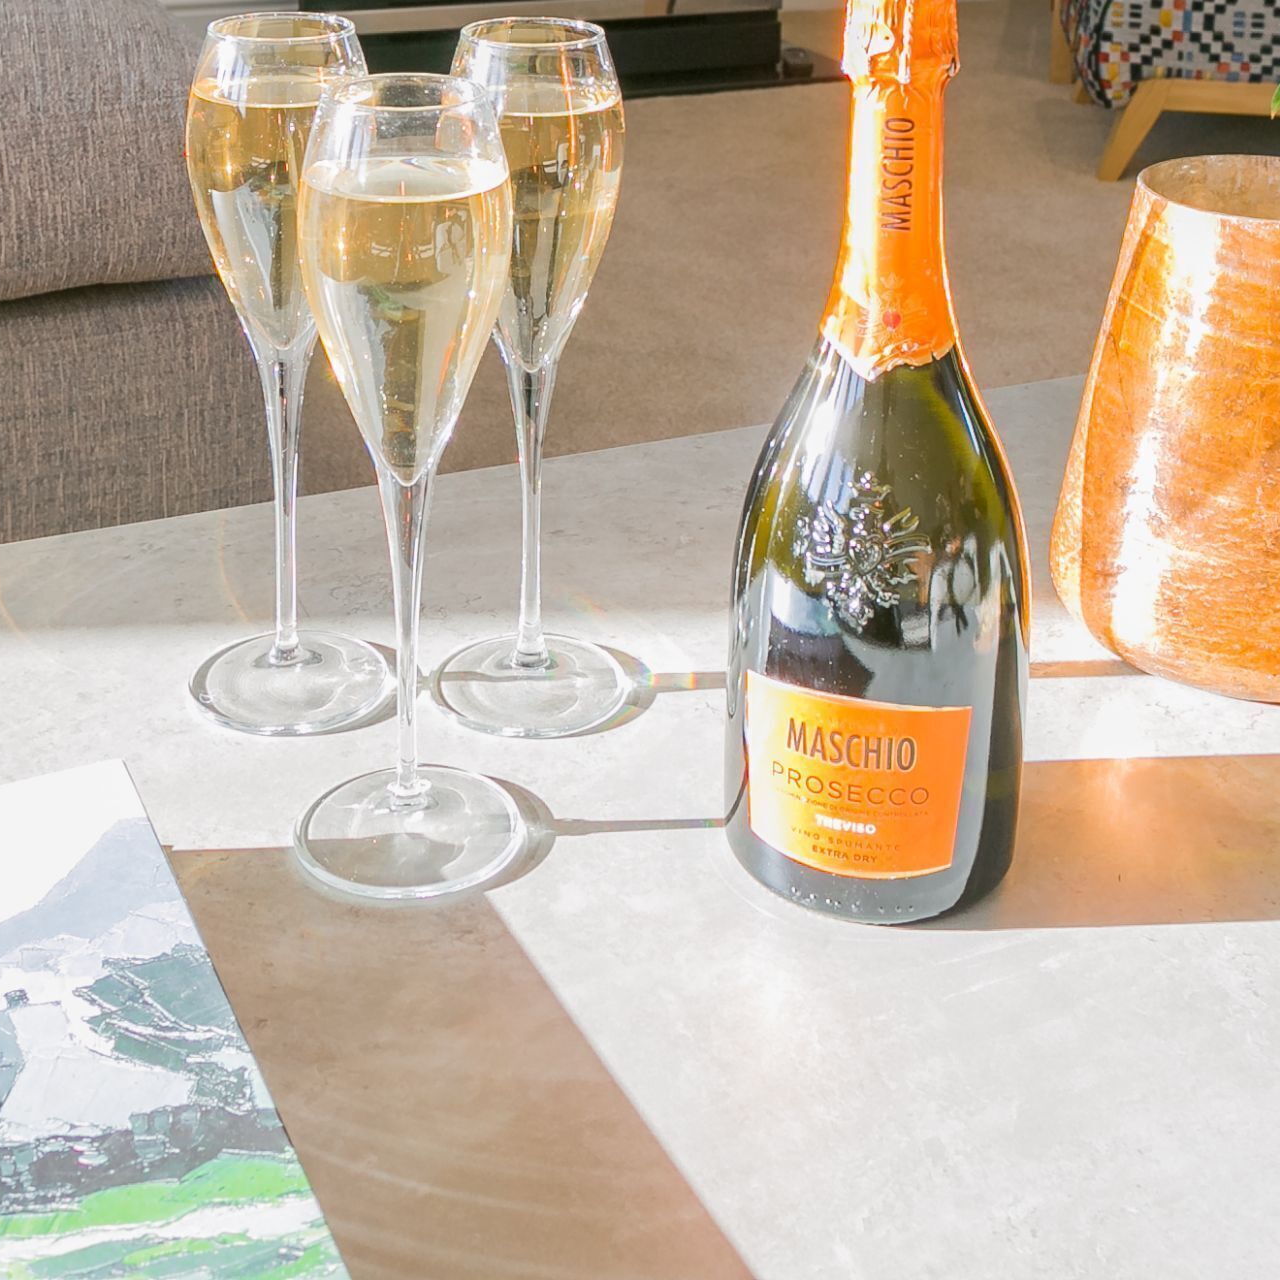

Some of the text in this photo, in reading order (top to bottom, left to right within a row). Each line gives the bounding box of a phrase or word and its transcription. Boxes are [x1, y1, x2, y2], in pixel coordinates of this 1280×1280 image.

[879, 118, 915, 232] MASCHIO
[786, 717, 917, 772] MASCHIO
[770, 761, 930, 806] PROSECCO
[811, 844, 879, 865] EXTRA DRY
